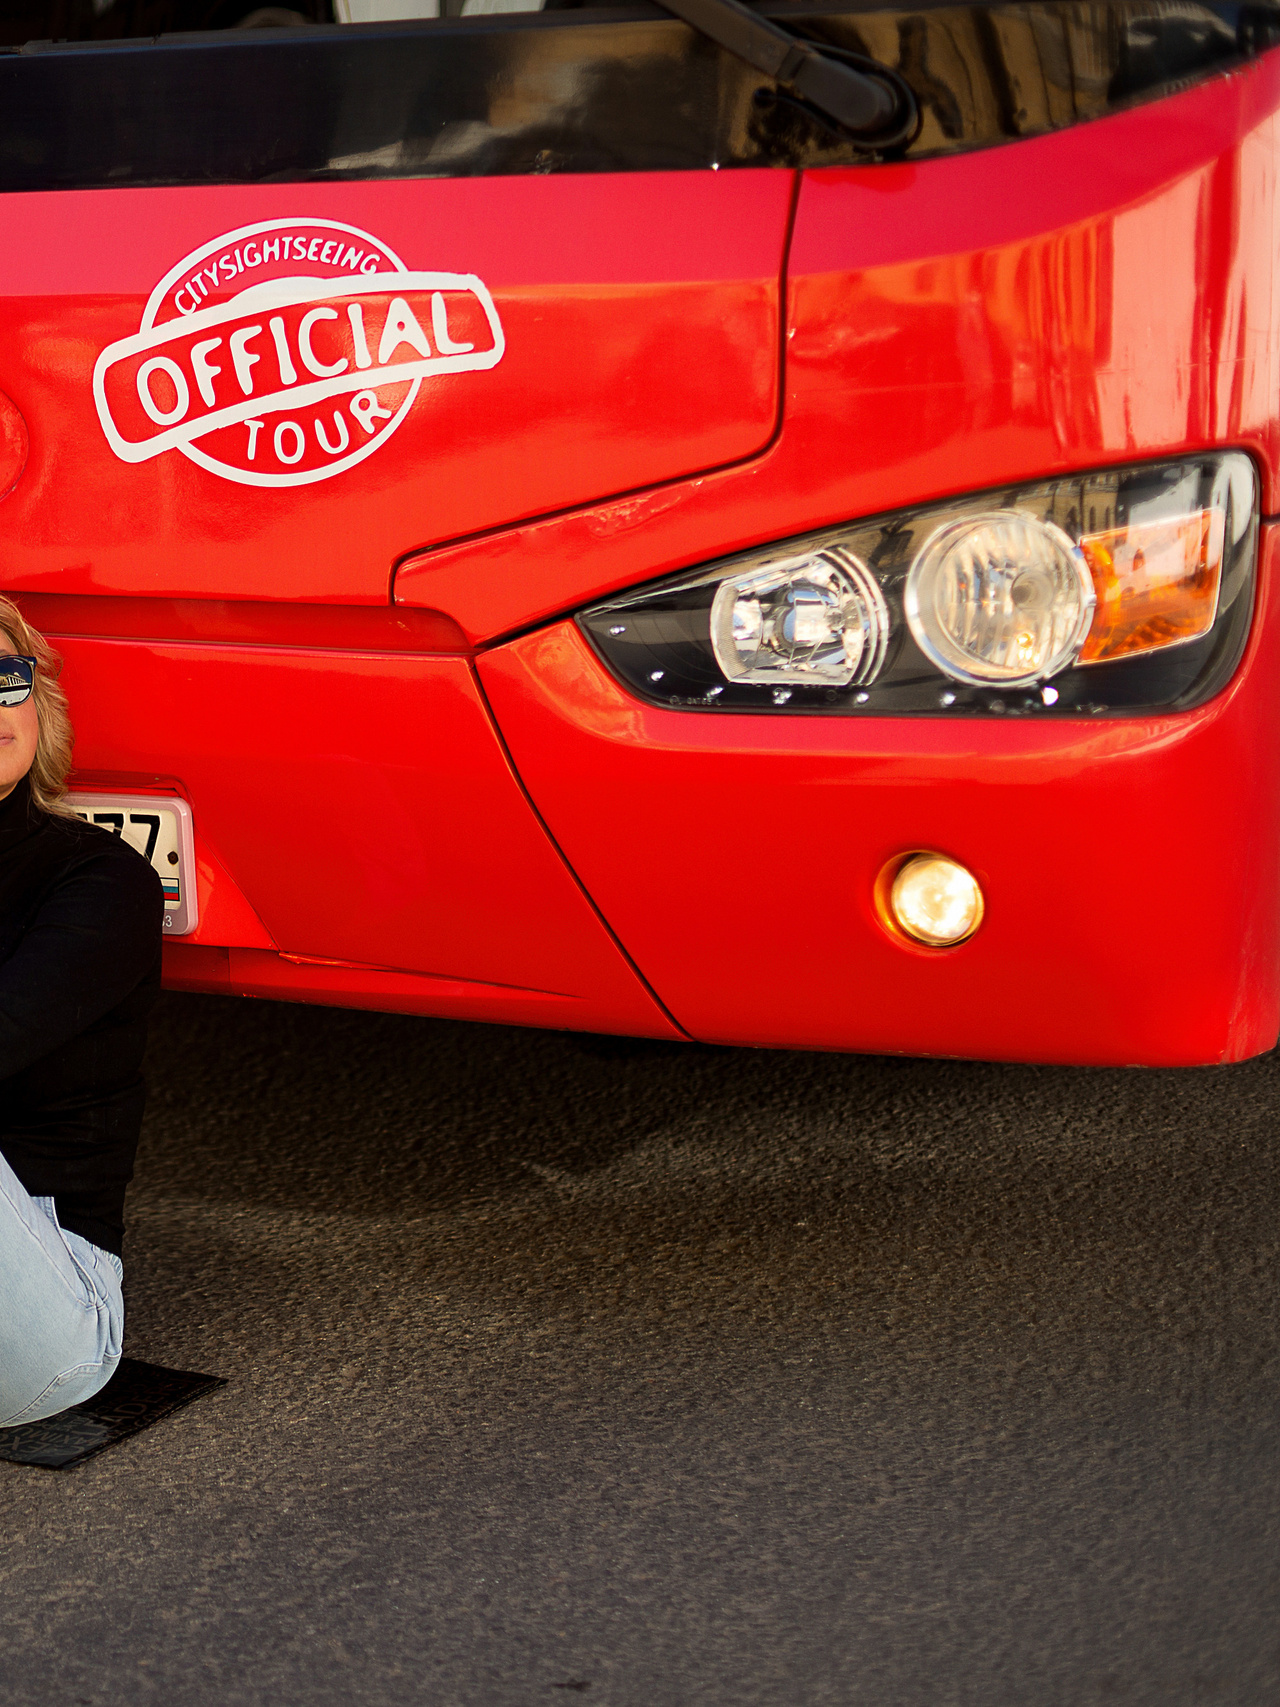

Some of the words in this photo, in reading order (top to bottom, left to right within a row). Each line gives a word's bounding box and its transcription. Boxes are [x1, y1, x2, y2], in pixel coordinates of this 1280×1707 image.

[174, 236, 382, 316] CITYSIGHTSEEING
[136, 292, 474, 426] OFFICIAL
[243, 388, 393, 464] TOUR
